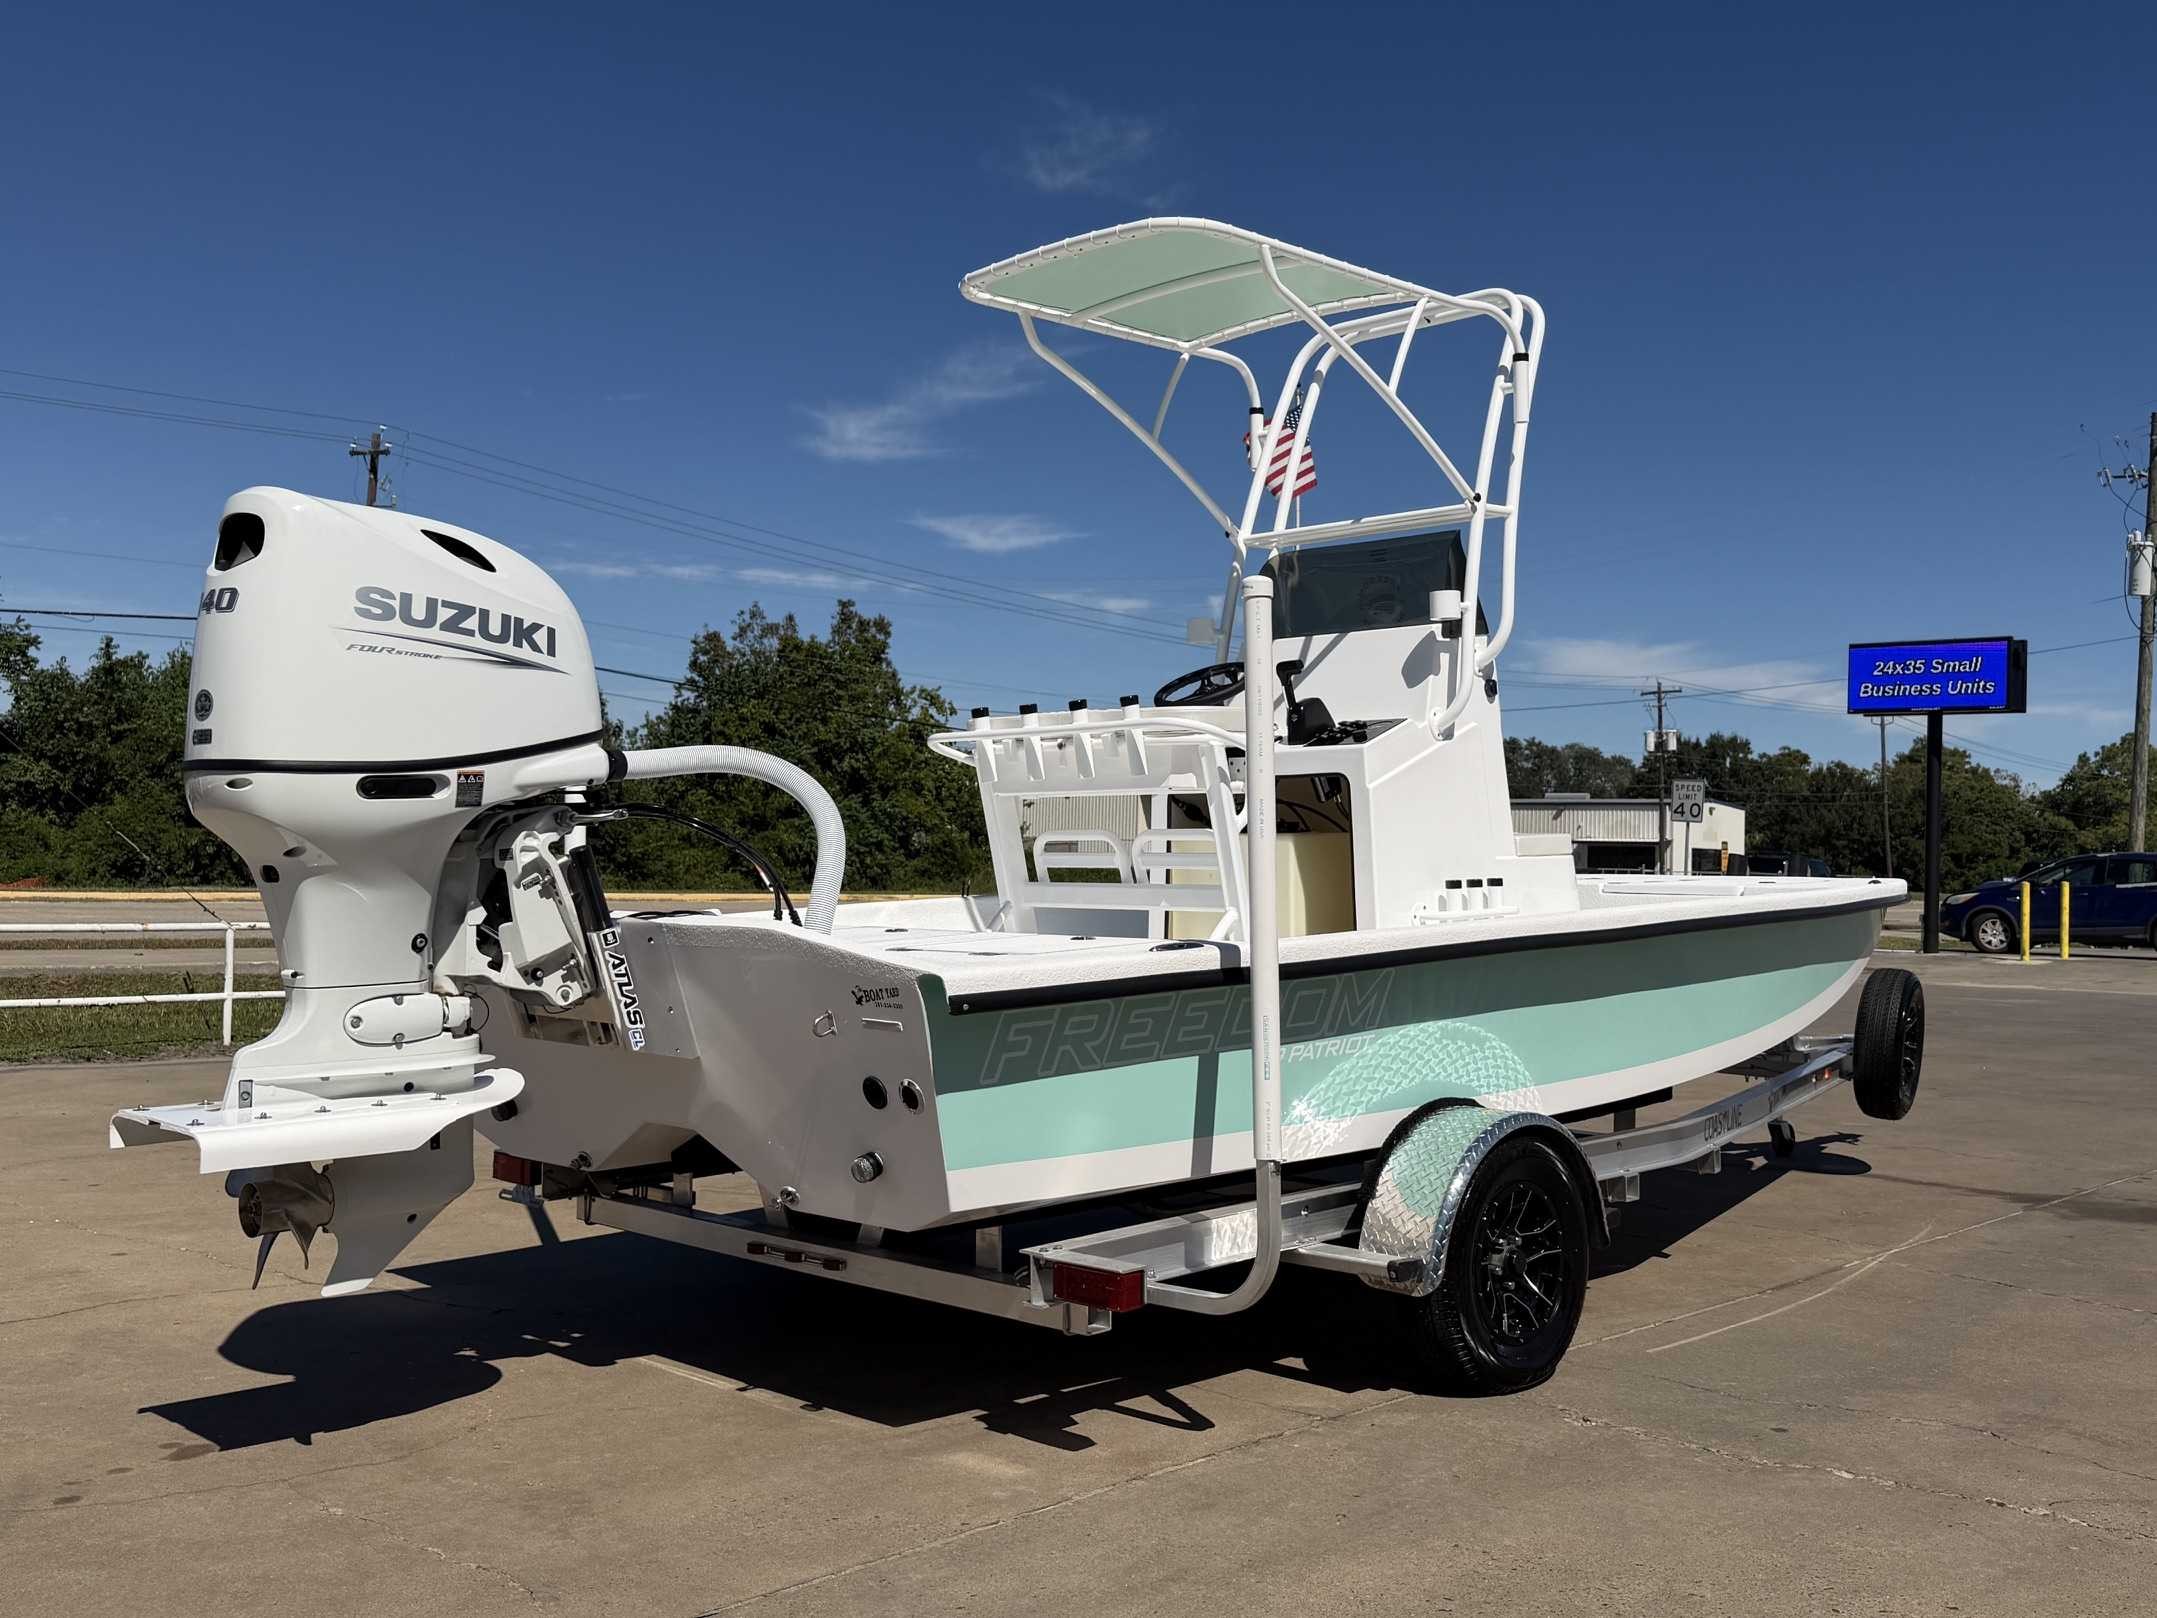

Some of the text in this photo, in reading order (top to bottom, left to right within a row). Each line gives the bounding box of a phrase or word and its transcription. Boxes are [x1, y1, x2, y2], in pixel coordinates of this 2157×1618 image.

[201, 587, 240, 614] 40
[354, 586, 556, 658] SUZUKI
[346, 643, 395, 655] FOUR
[1872, 656, 1982, 676] 24x35 Small
[1859, 678, 1996, 698] Business Units
[1675, 784, 1702, 792] SPEED
[1678, 793, 1697, 801] LIMIT
[1673, 802, 1701, 818] 40
[607, 951, 645, 1027] ATLAS
[863, 988, 885, 1003] BOAT
[1287, 1034, 1376, 1063] PATRIOT
